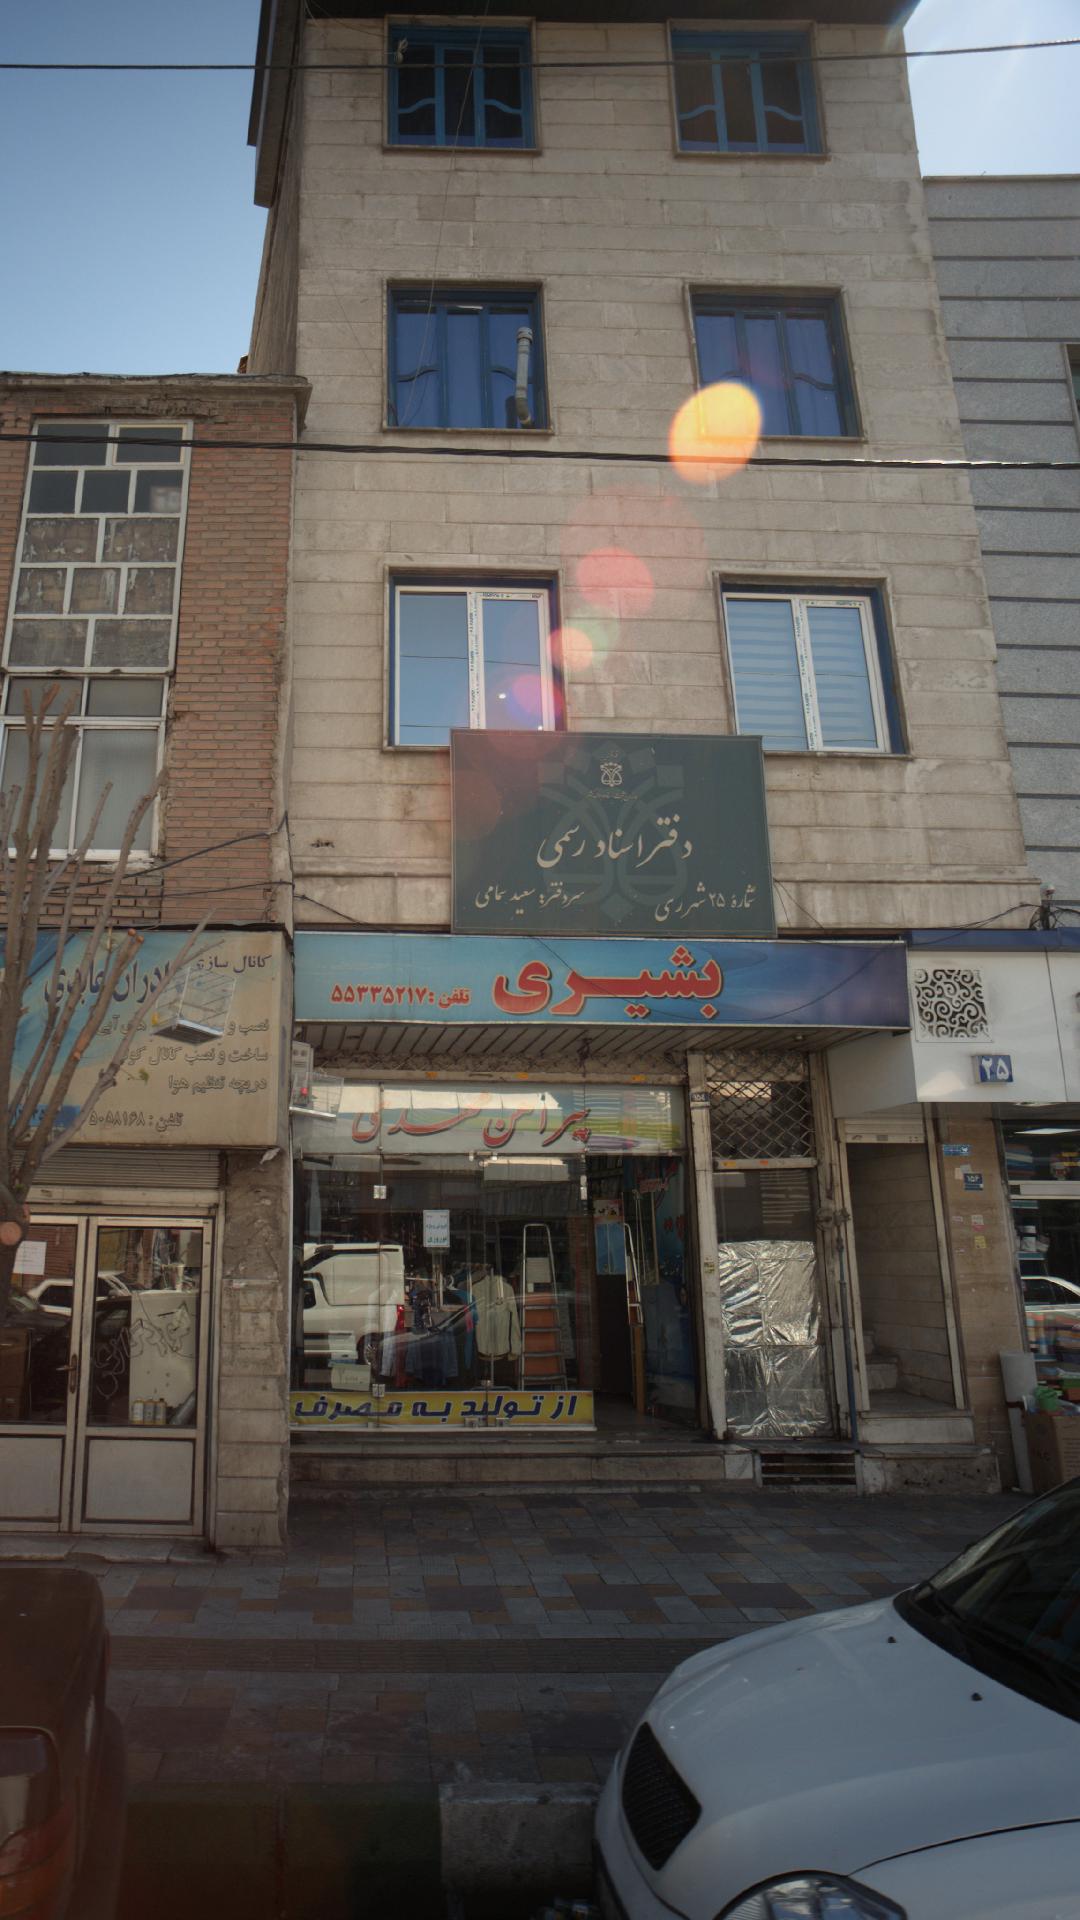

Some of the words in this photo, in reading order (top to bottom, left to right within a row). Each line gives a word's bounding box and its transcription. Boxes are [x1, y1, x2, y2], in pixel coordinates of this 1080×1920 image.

[536, 824, 586, 868] رسمی
[593, 828, 643, 859] اسناد
[634, 814, 693, 868] دفتر
[509, 888, 536, 914] سعید
[654, 897, 684, 922] ری
[680, 881, 706, 919] شهر
[708, 891, 726, 908] ۲۵
[233, 954, 272, 973] کانال
[493, 944, 723, 1020] بشیری
[330, 983, 428, 1005] ۵۵۳۳۵۲۱۷
[238, 1018, 270, 1036] نصب
[149, 1046, 183, 1066] کانال
[185, 1049, 216, 1066] نصب
[217, 1050, 227, 1066] و
[228, 1047, 269, 1062] ساخت
[981, 1057, 1010, 1081] ۲۵
[168, 1075, 189, 1095] هوا
[192, 1075, 226, 1095] تنظیم
[294, 1395, 403, 1420] مصرف
[411, 1400, 453, 1422] به
[460, 1395, 545, 1420] تولید
[550, 1395, 578, 1419] از
